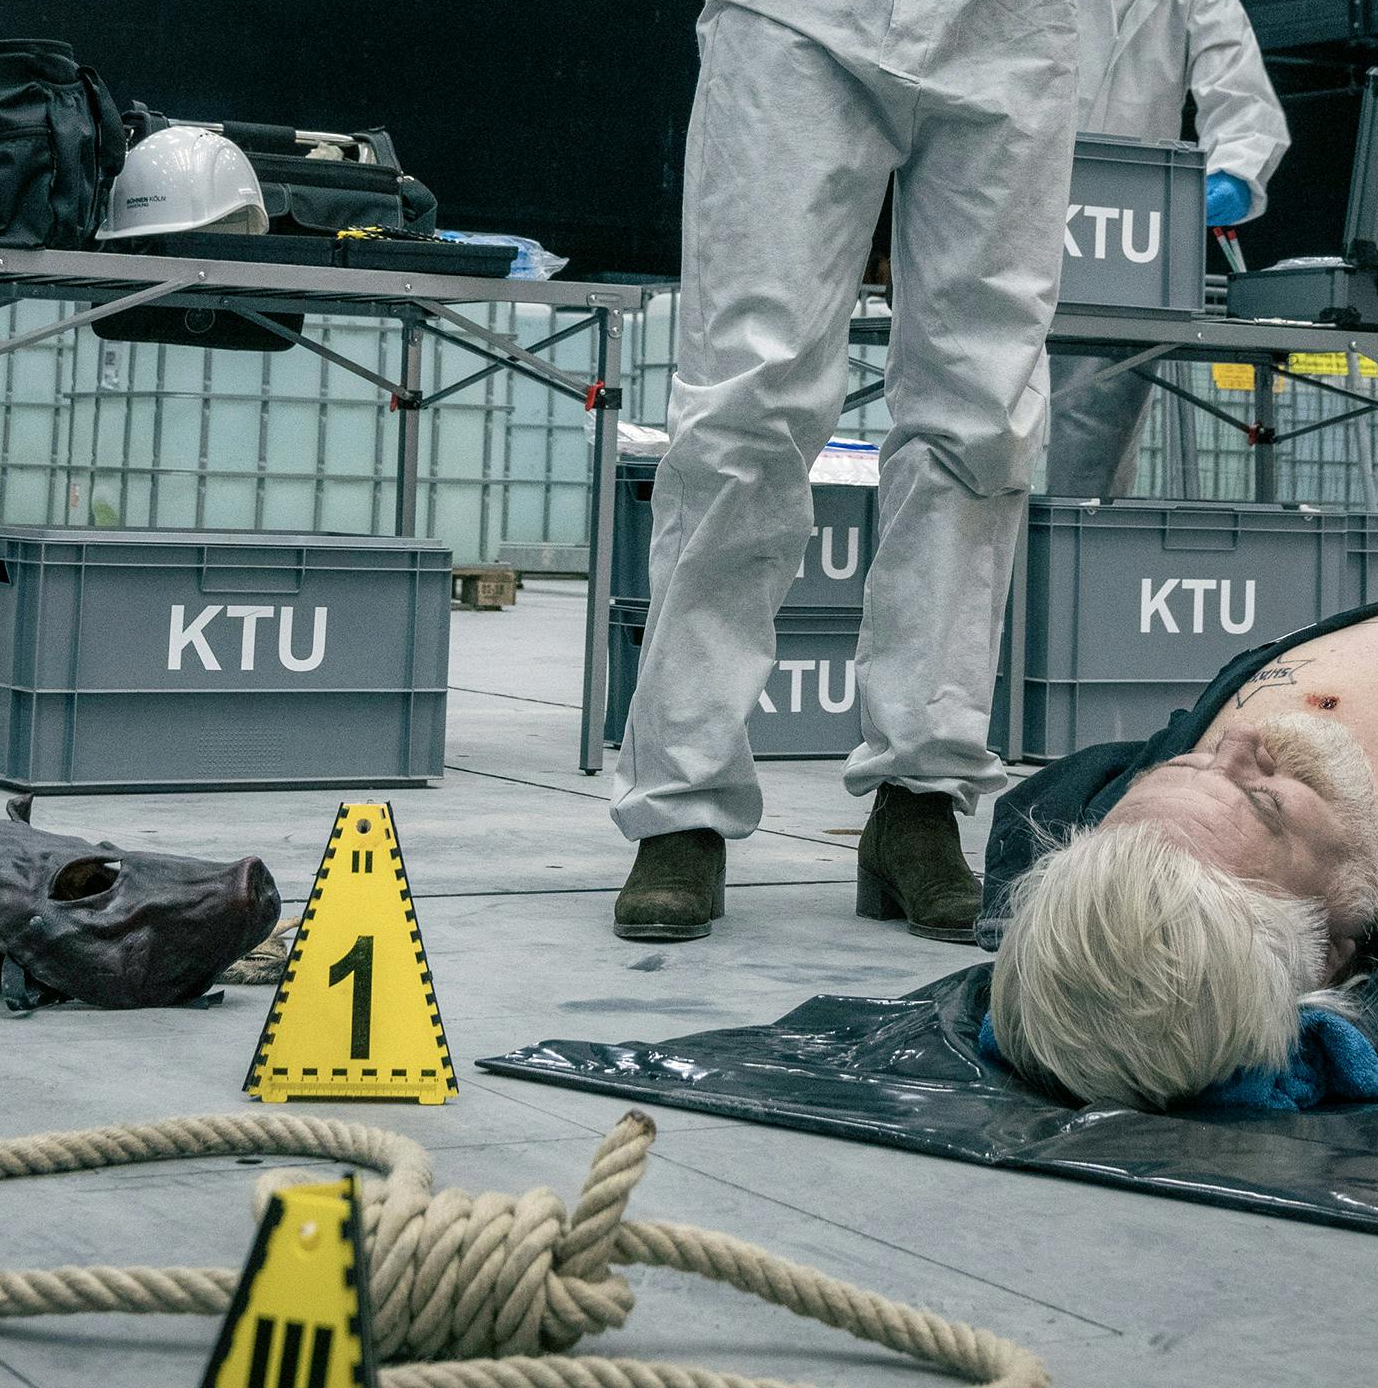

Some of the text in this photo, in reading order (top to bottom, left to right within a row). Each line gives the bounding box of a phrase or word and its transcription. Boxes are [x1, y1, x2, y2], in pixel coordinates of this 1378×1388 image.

[1140, 578, 1256, 635] KTU
[167, 604, 328, 672] KTU
[757, 659, 857, 714] TU
[328, 935, 374, 1060] 1
